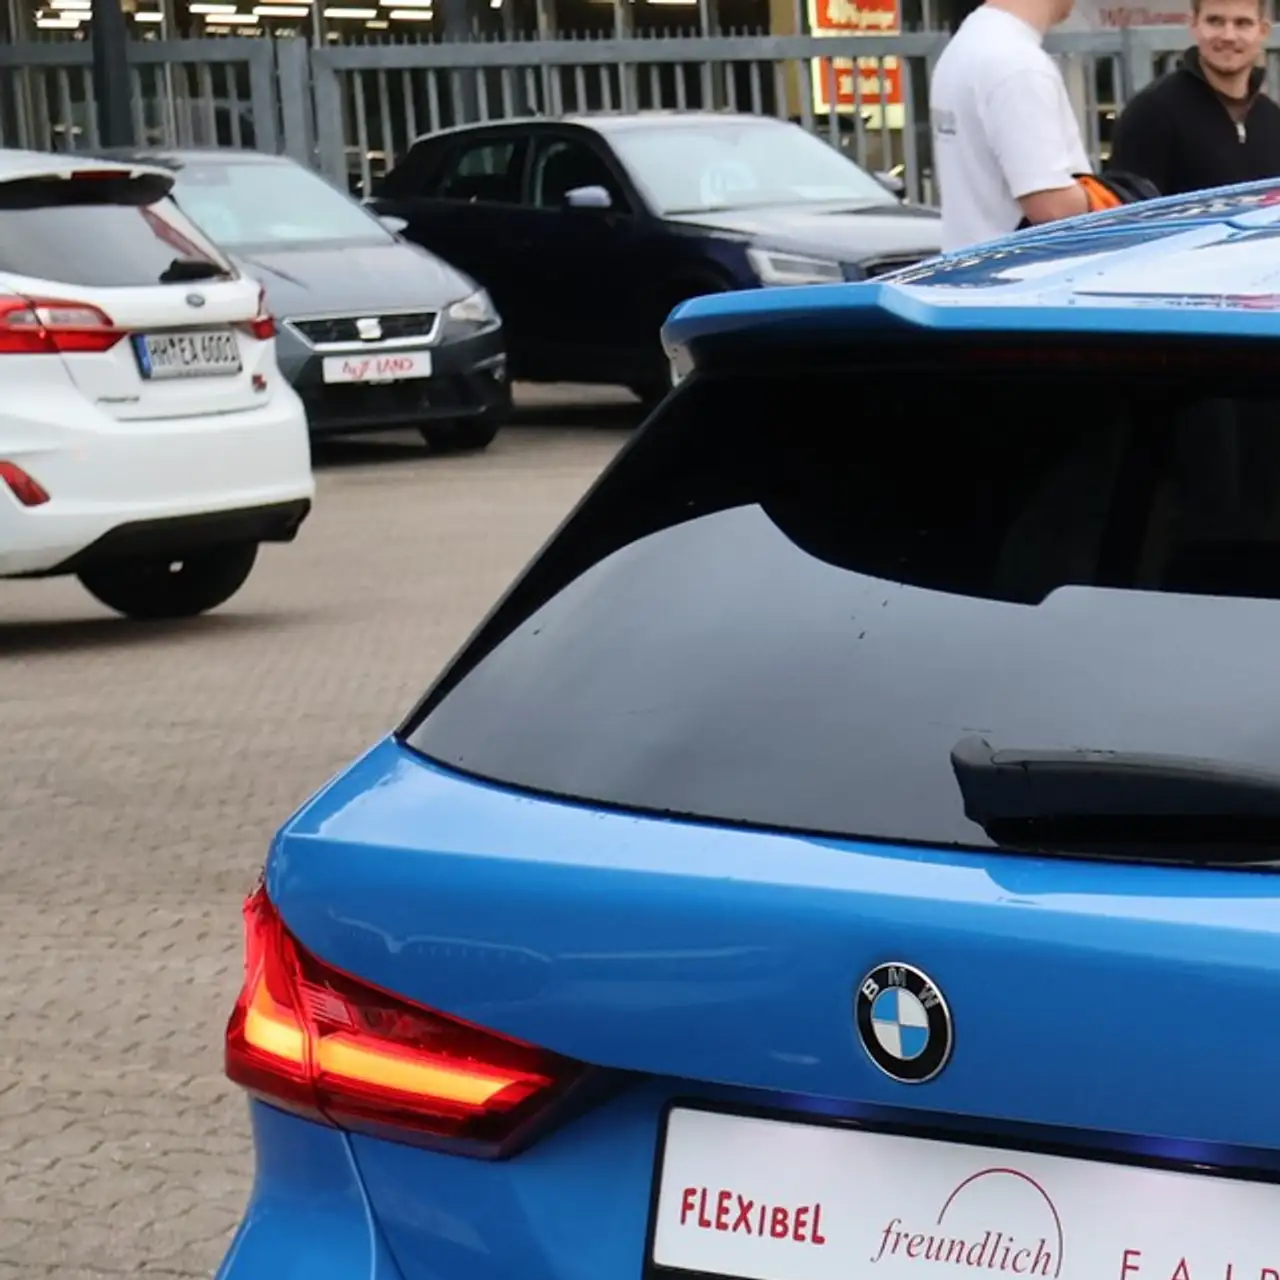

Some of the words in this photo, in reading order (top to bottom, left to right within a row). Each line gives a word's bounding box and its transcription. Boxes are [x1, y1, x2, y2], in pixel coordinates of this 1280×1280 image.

[861, 967, 941, 1009] BMW
[680, 1186, 826, 1246] FLEXIBEL
[869, 1218, 1055, 1277] freundlich
